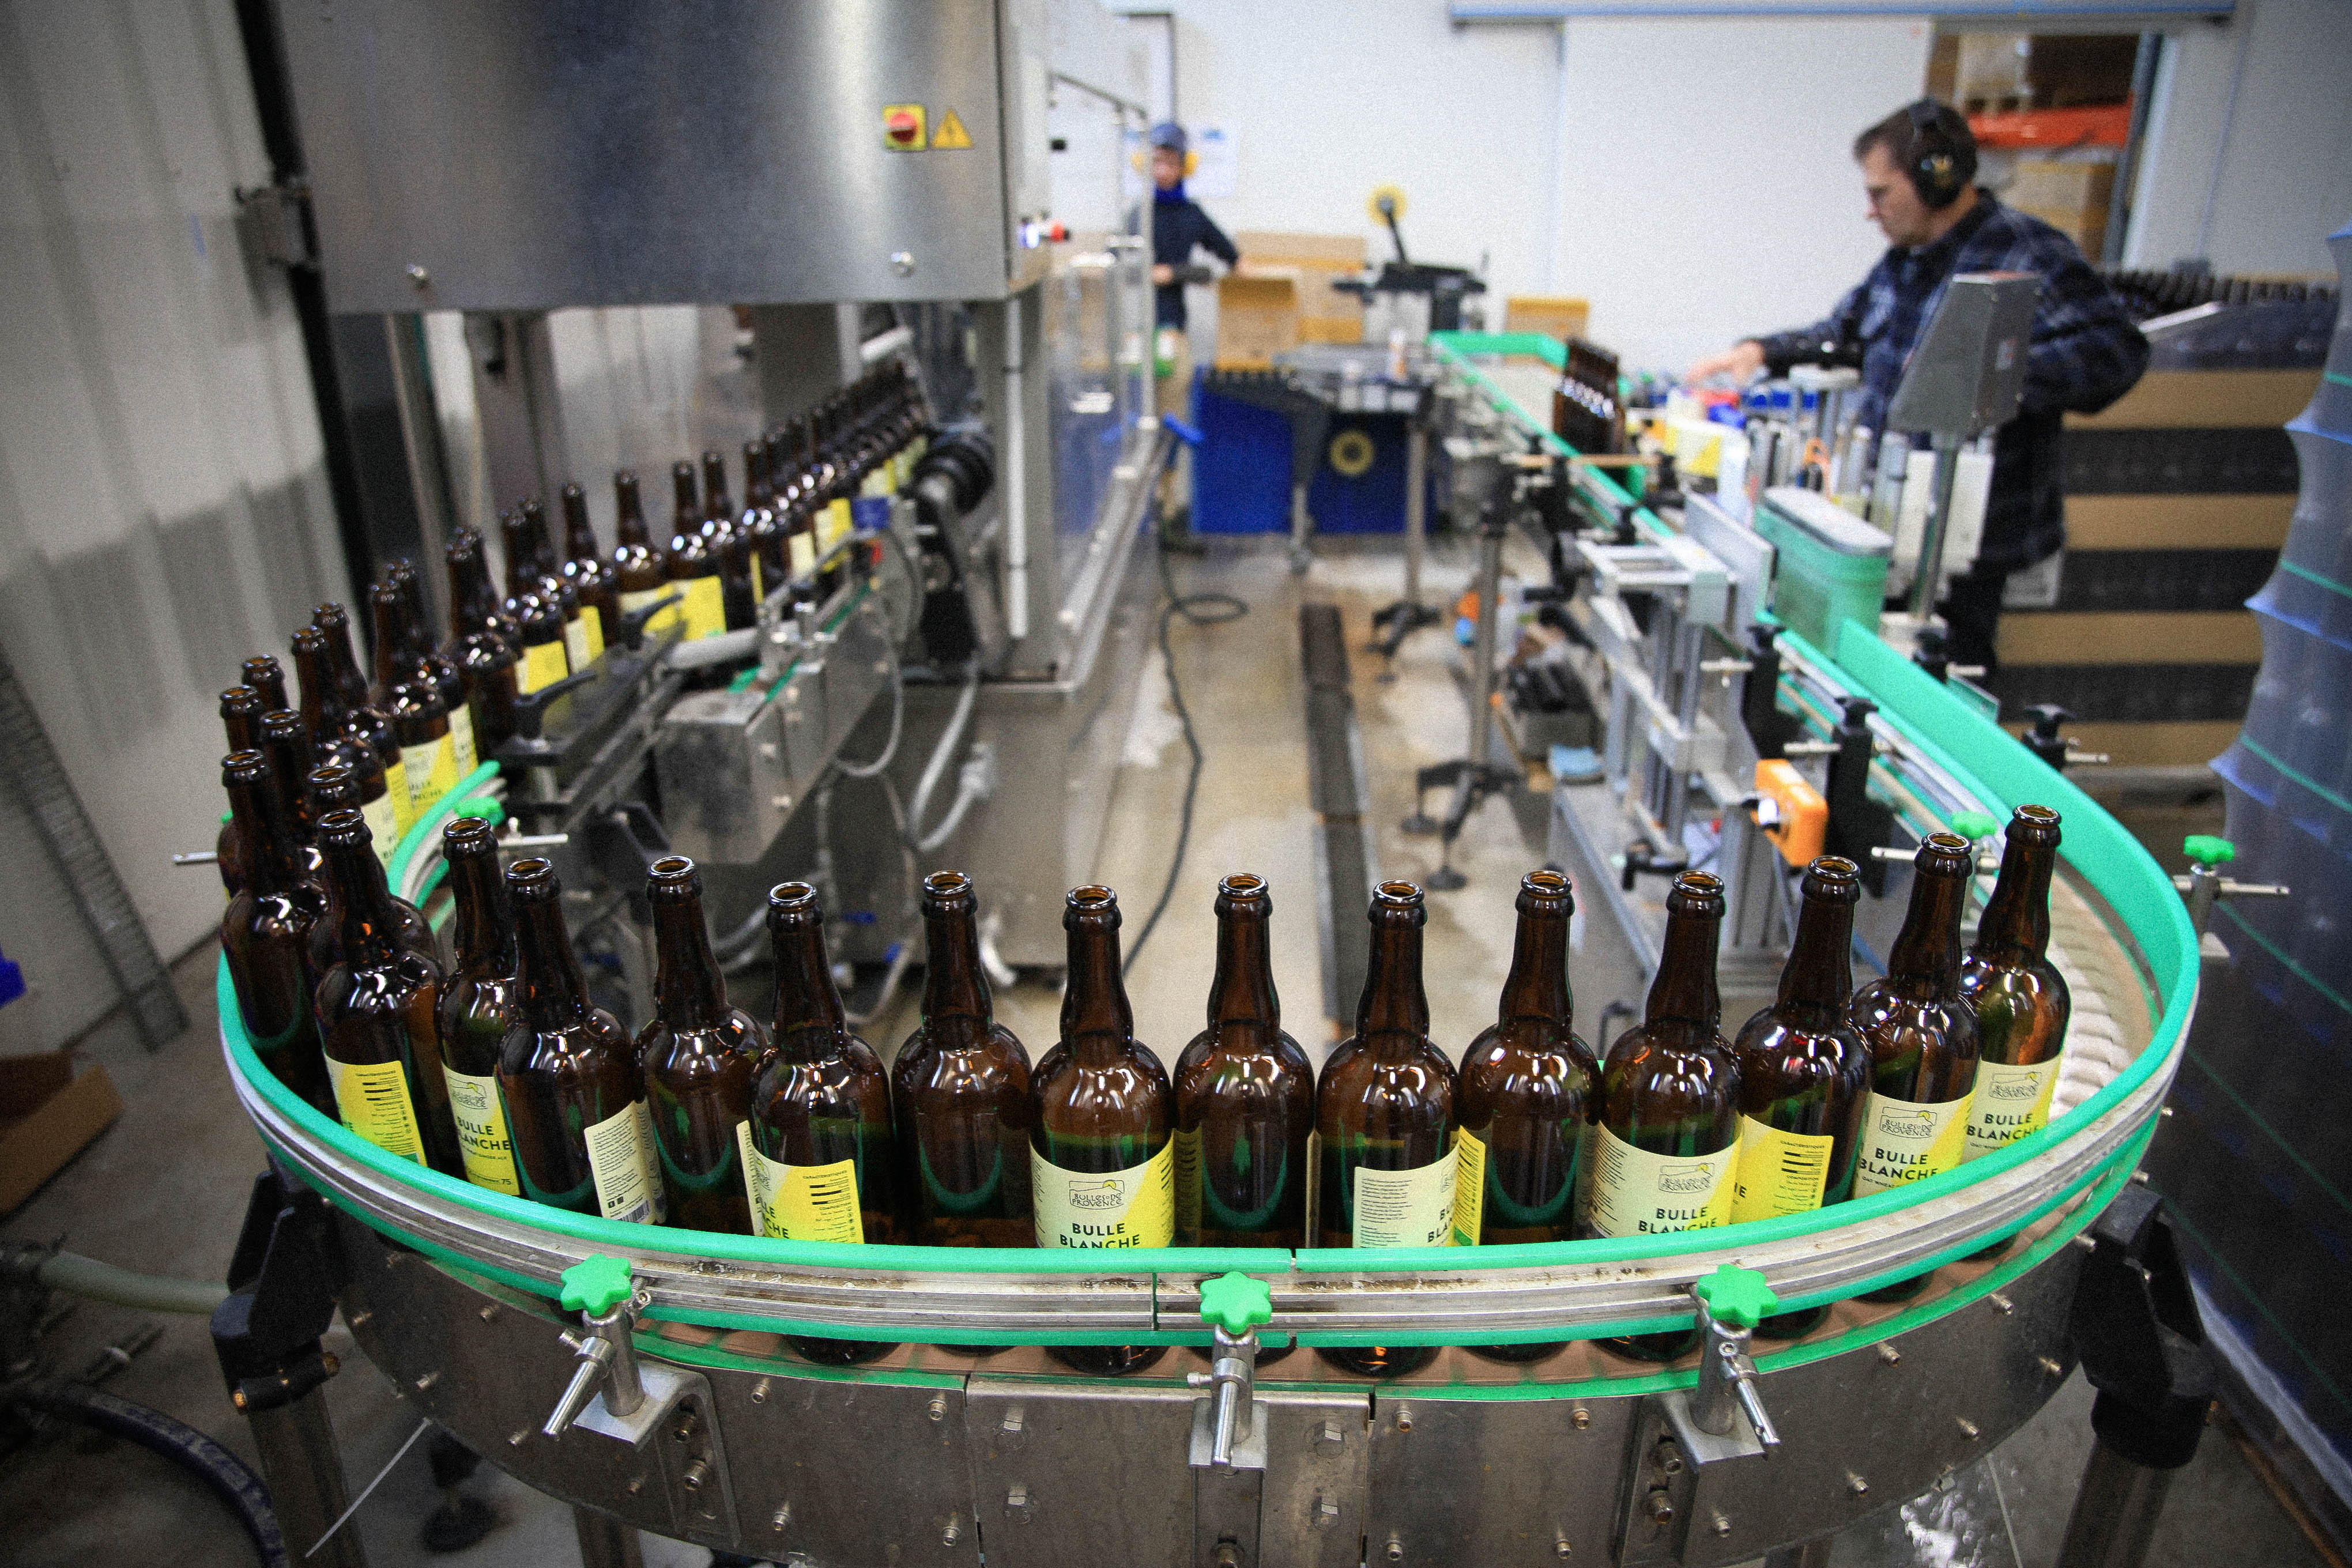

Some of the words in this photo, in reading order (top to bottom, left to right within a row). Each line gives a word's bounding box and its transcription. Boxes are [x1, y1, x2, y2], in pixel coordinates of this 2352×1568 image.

[1985, 1113, 2034, 1125] BULLE
[1875, 1147, 1928, 1165] BULLE
[1656, 1206, 1708, 1220] BULLE
[1072, 1223, 1125, 1237] BULLE
